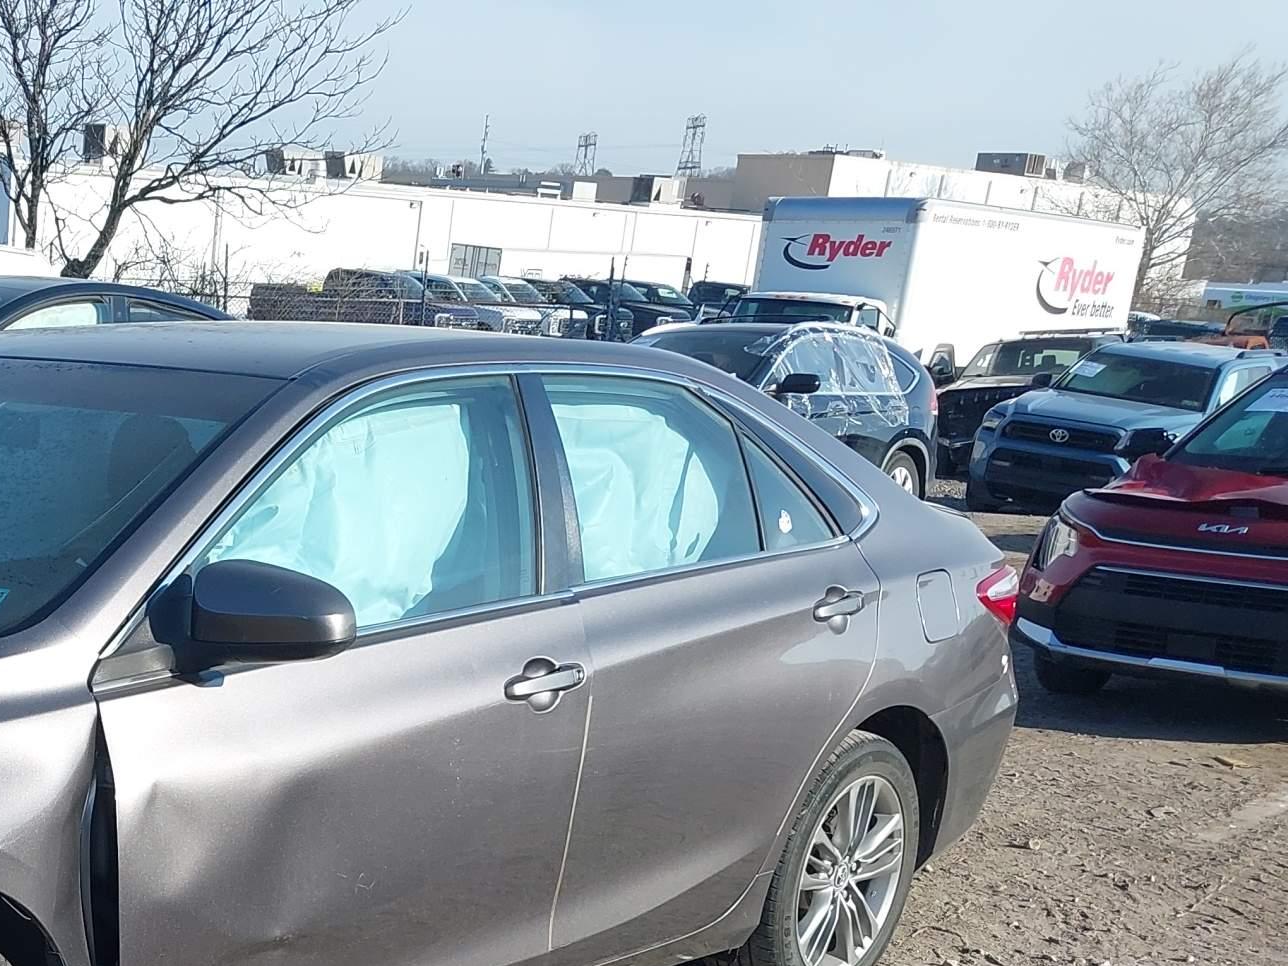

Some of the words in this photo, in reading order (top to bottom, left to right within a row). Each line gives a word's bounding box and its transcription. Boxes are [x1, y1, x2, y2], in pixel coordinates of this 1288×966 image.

[807, 233, 893, 262] Ryder
[1053, 256, 1115, 302] Ryder
[1071, 299, 1090, 319] Ever
[1197, 523, 1249, 535] KIA
